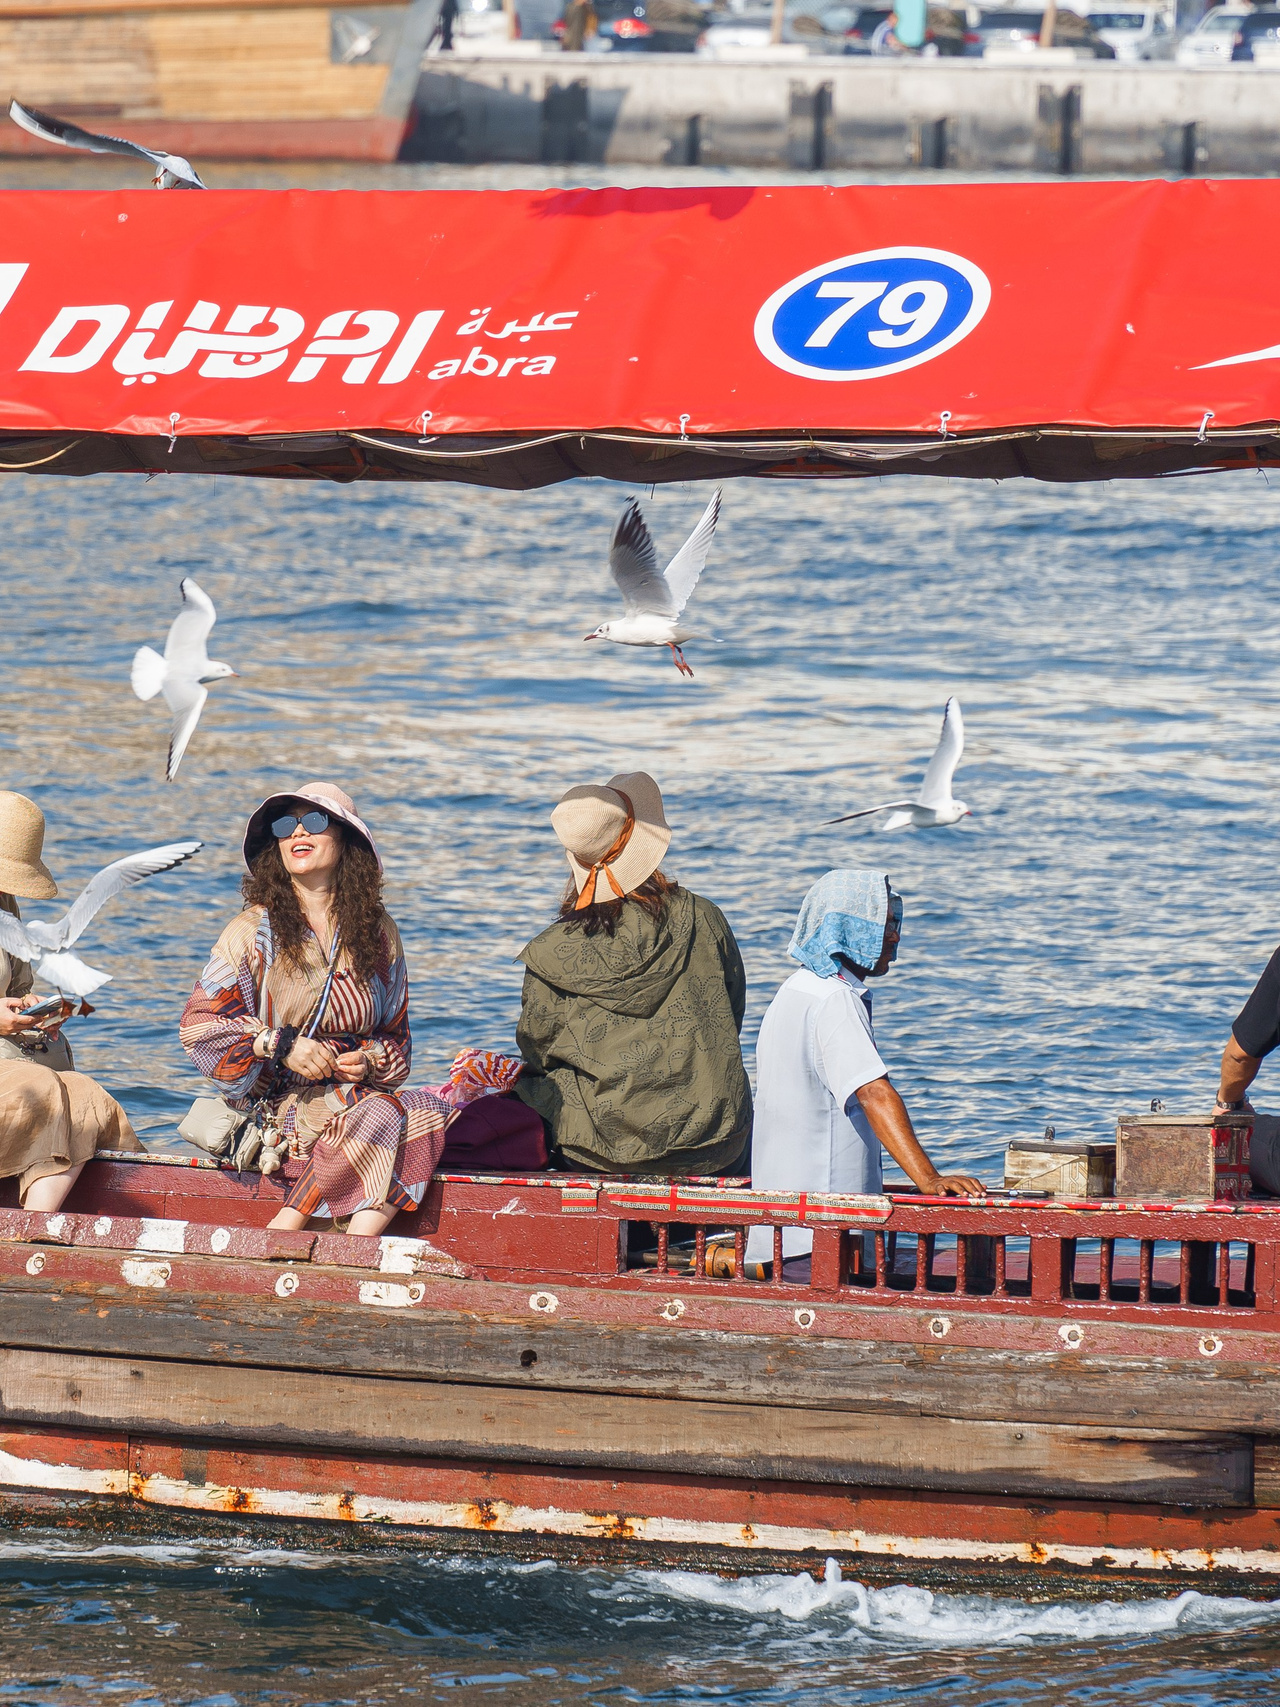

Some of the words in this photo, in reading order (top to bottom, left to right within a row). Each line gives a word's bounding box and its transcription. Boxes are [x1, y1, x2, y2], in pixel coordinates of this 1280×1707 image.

[456, 306, 580, 343] عبرة
[804, 280, 948, 349] 79
[17, 300, 445, 386] DUBAI
[427, 346, 557, 381] abra
